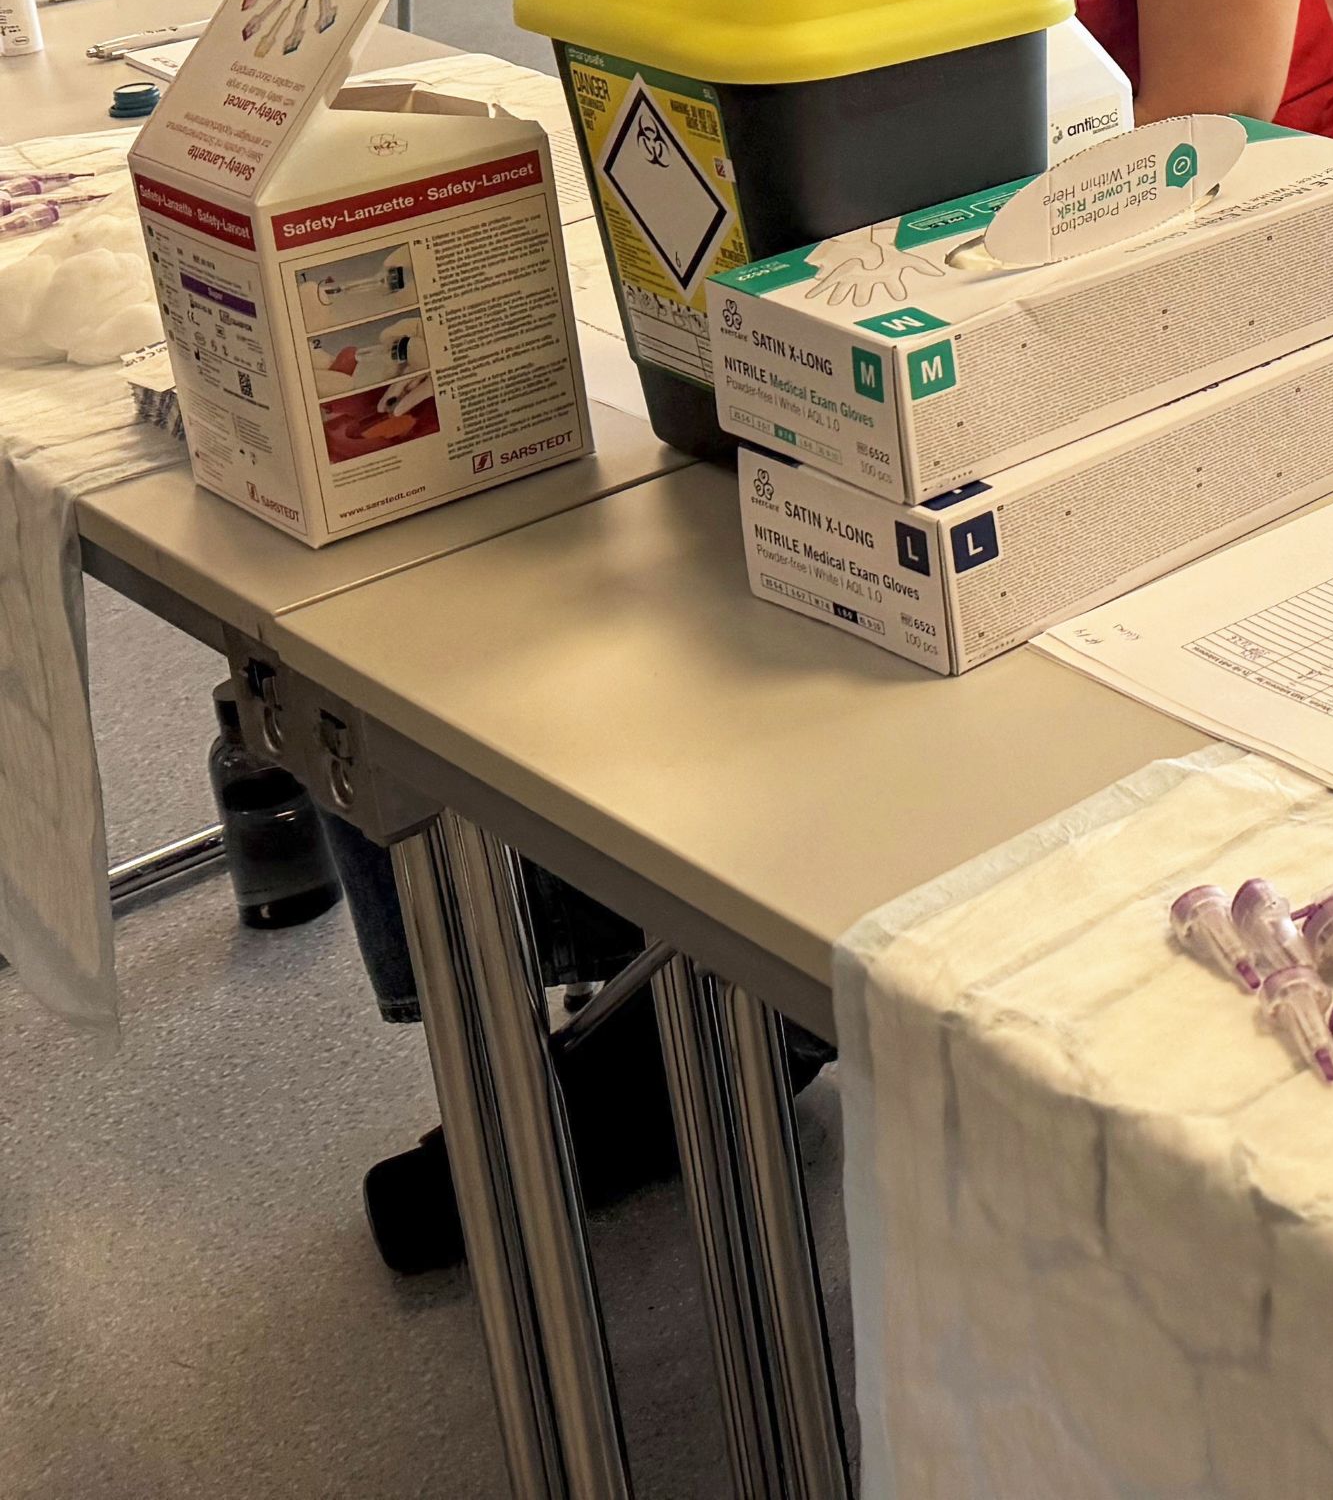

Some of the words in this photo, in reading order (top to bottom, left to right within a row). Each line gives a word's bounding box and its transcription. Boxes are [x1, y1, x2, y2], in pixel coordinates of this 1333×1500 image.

[573, 69, 611, 101] DANGER
[223, 93, 287, 126] Safety-Lancet
[1067, 108, 1118, 137] antibac
[187, 145, 255, 181] Safety-Lanzette
[1127, 154, 1156, 176] Start
[1081, 168, 1123, 191] Within
[1136, 170, 1157, 186] For
[282, 195, 415, 237] Safety-Lanzette
[426, 163, 535, 201] Safety-Lancet
[1043, 187, 1075, 206] Here
[1092, 180, 1132, 204] Lower
[1125, 187, 1157, 209] Safer
[1051, 202, 1119, 236] Protection
[1057, 197, 1086, 219] Risk
[311, 339, 322, 350] 2
[752, 330, 786, 357] SATIN
[788, 344, 833, 376] X-LONG
[860, 362, 875, 388] M
[921, 356, 944, 384] M
[724, 355, 767, 383] NITRILE
[769, 372, 807, 401] Medical
[810, 391, 838, 414] Exam
[840, 401, 875, 429] Gloves
[726, 375, 773, 406] Powder-free
[806, 409, 825, 428] AQL
[500, 430, 573, 465] SARSTEDT
[868, 446, 891, 465] 6522
[859, 461, 877, 478] 100
[877, 469, 893, 486] pcs
[338, 485, 426, 520] www.sarstedt.com
[785, 500, 822, 529] SATIN
[825, 516, 875, 549] X-LONG
[906, 535, 919, 562] L
[967, 532, 983, 556] L
[754, 523, 800, 554] NITRILE
[803, 543, 846, 572] Medical
[849, 561, 880, 586] Exam
[883, 574, 920, 601] Gloves
[756, 543, 808, 574] Powder-free
[813, 567, 840, 587] White
[846, 577, 866, 597] AQL
[913, 616, 937, 637] 6523
[905, 630, 922, 649] 100
[923, 639, 938, 656] pcs
